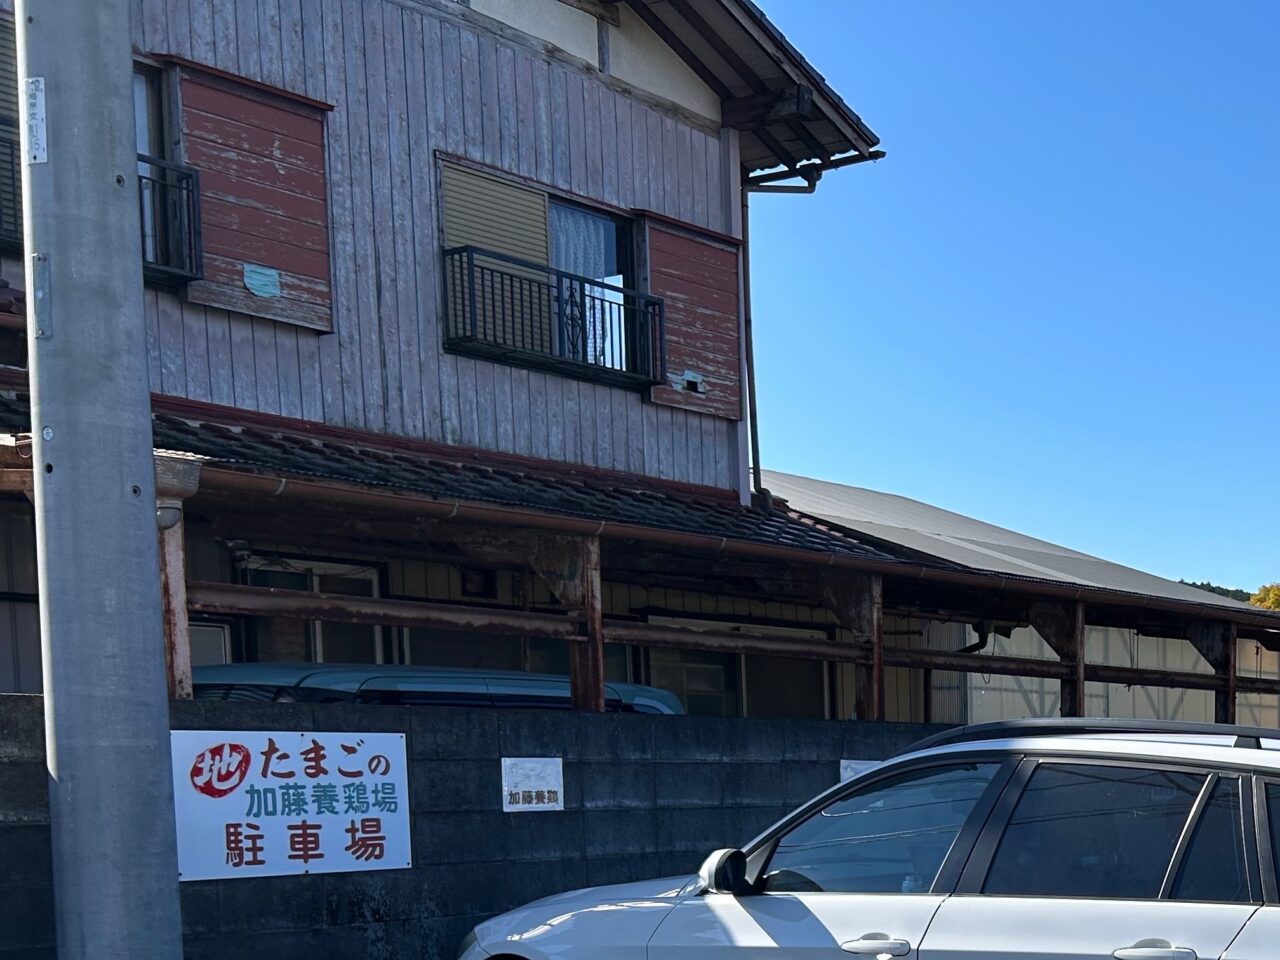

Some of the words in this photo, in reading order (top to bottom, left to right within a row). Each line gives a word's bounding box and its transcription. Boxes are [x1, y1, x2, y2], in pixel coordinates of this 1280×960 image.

[245, 781, 398, 818] 加藤養鶏場
